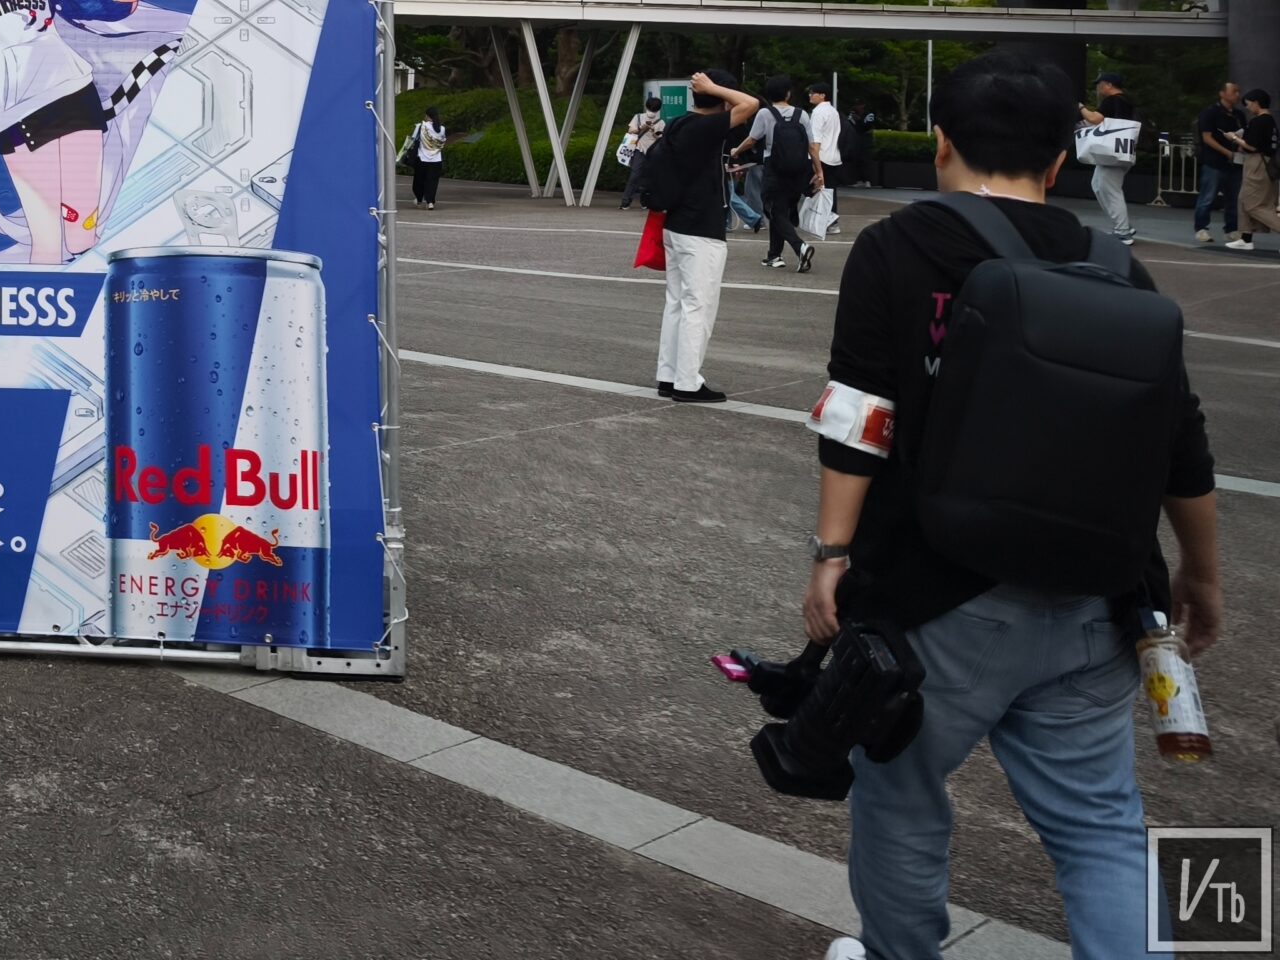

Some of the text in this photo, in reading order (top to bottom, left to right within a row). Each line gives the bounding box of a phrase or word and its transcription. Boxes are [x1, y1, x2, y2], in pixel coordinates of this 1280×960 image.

[114, 444, 319, 511] Red Bull
[119, 573, 312, 603] ENERGY DRINK
